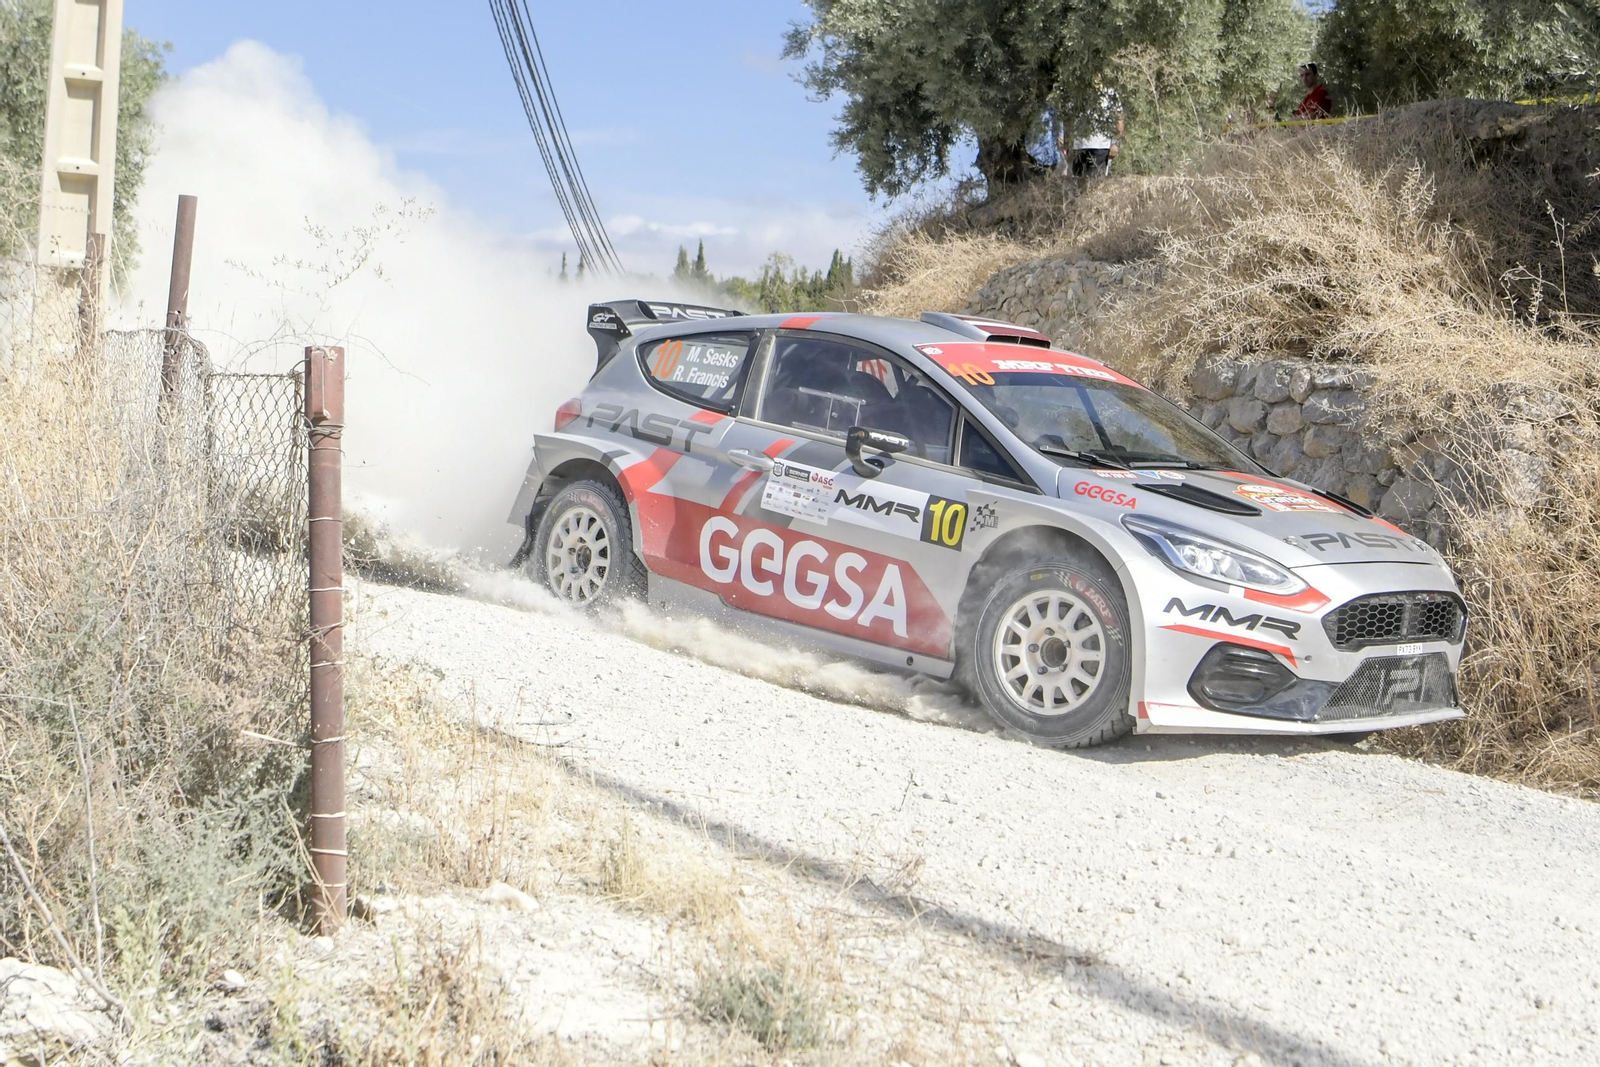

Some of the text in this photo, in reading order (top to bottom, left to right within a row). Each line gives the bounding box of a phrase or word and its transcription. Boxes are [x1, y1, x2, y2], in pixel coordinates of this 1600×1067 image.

[592, 312, 616, 322] GT
[649, 305, 726, 320] PAST
[651, 339, 683, 379] 10
[686, 346, 739, 368] M. Sesks
[672, 365, 729, 388] R. Francis
[948, 363, 996, 386] 10
[586, 402, 714, 453] PAST
[869, 432, 910, 446] PAST
[818, 477, 834, 486] ASC
[834, 489, 921, 524] MMR
[929, 499, 967, 547] 10
[1300, 531, 1414, 552] PAST
[1084, 587, 1112, 619] MRF
[1163, 597, 1302, 641] MMR
